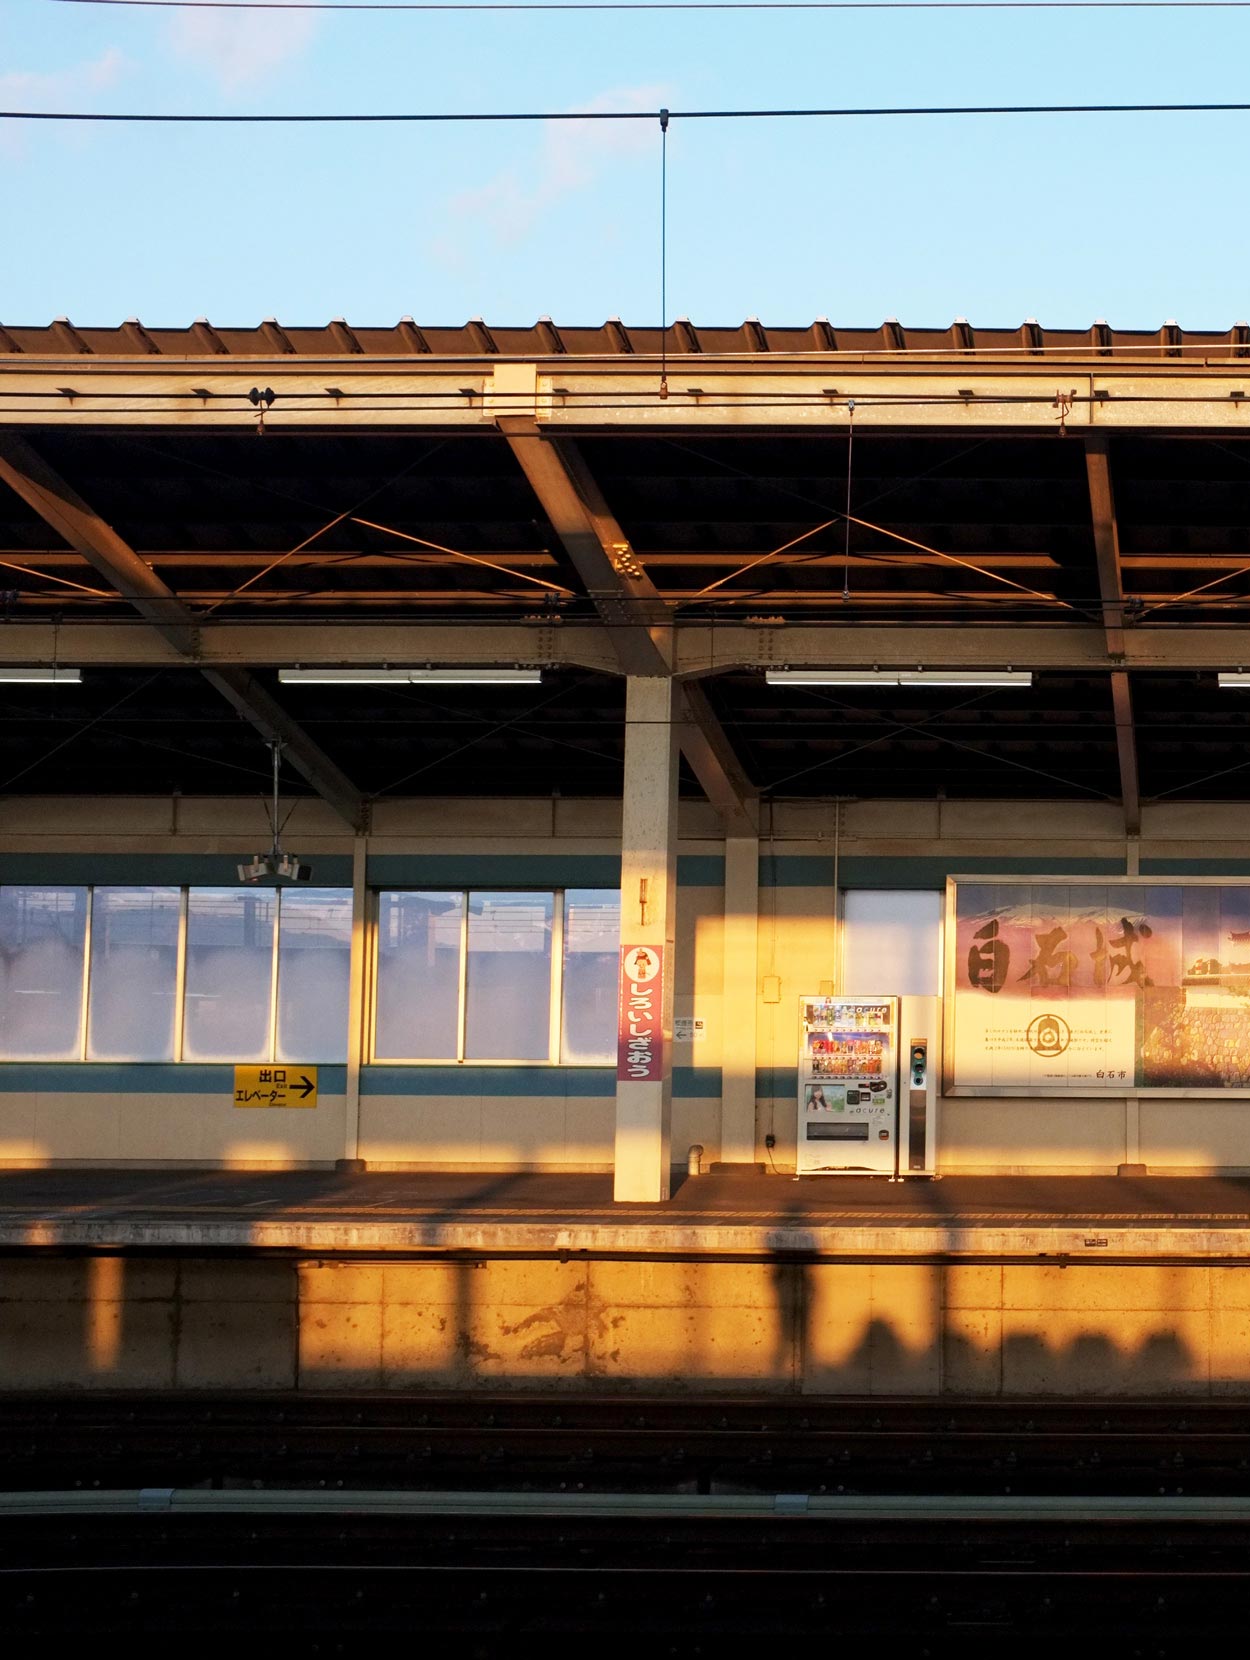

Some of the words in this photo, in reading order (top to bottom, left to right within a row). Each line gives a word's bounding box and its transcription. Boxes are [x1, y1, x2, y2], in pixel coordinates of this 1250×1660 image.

[968, 917, 1155, 993] 白石城
[627, 983, 653, 1078] しろいしざおう
[259, 1069, 286, 1082] 出口
[1096, 1069, 1127, 1080] 白石市
[236, 1090, 286, 1102] エレベーター
